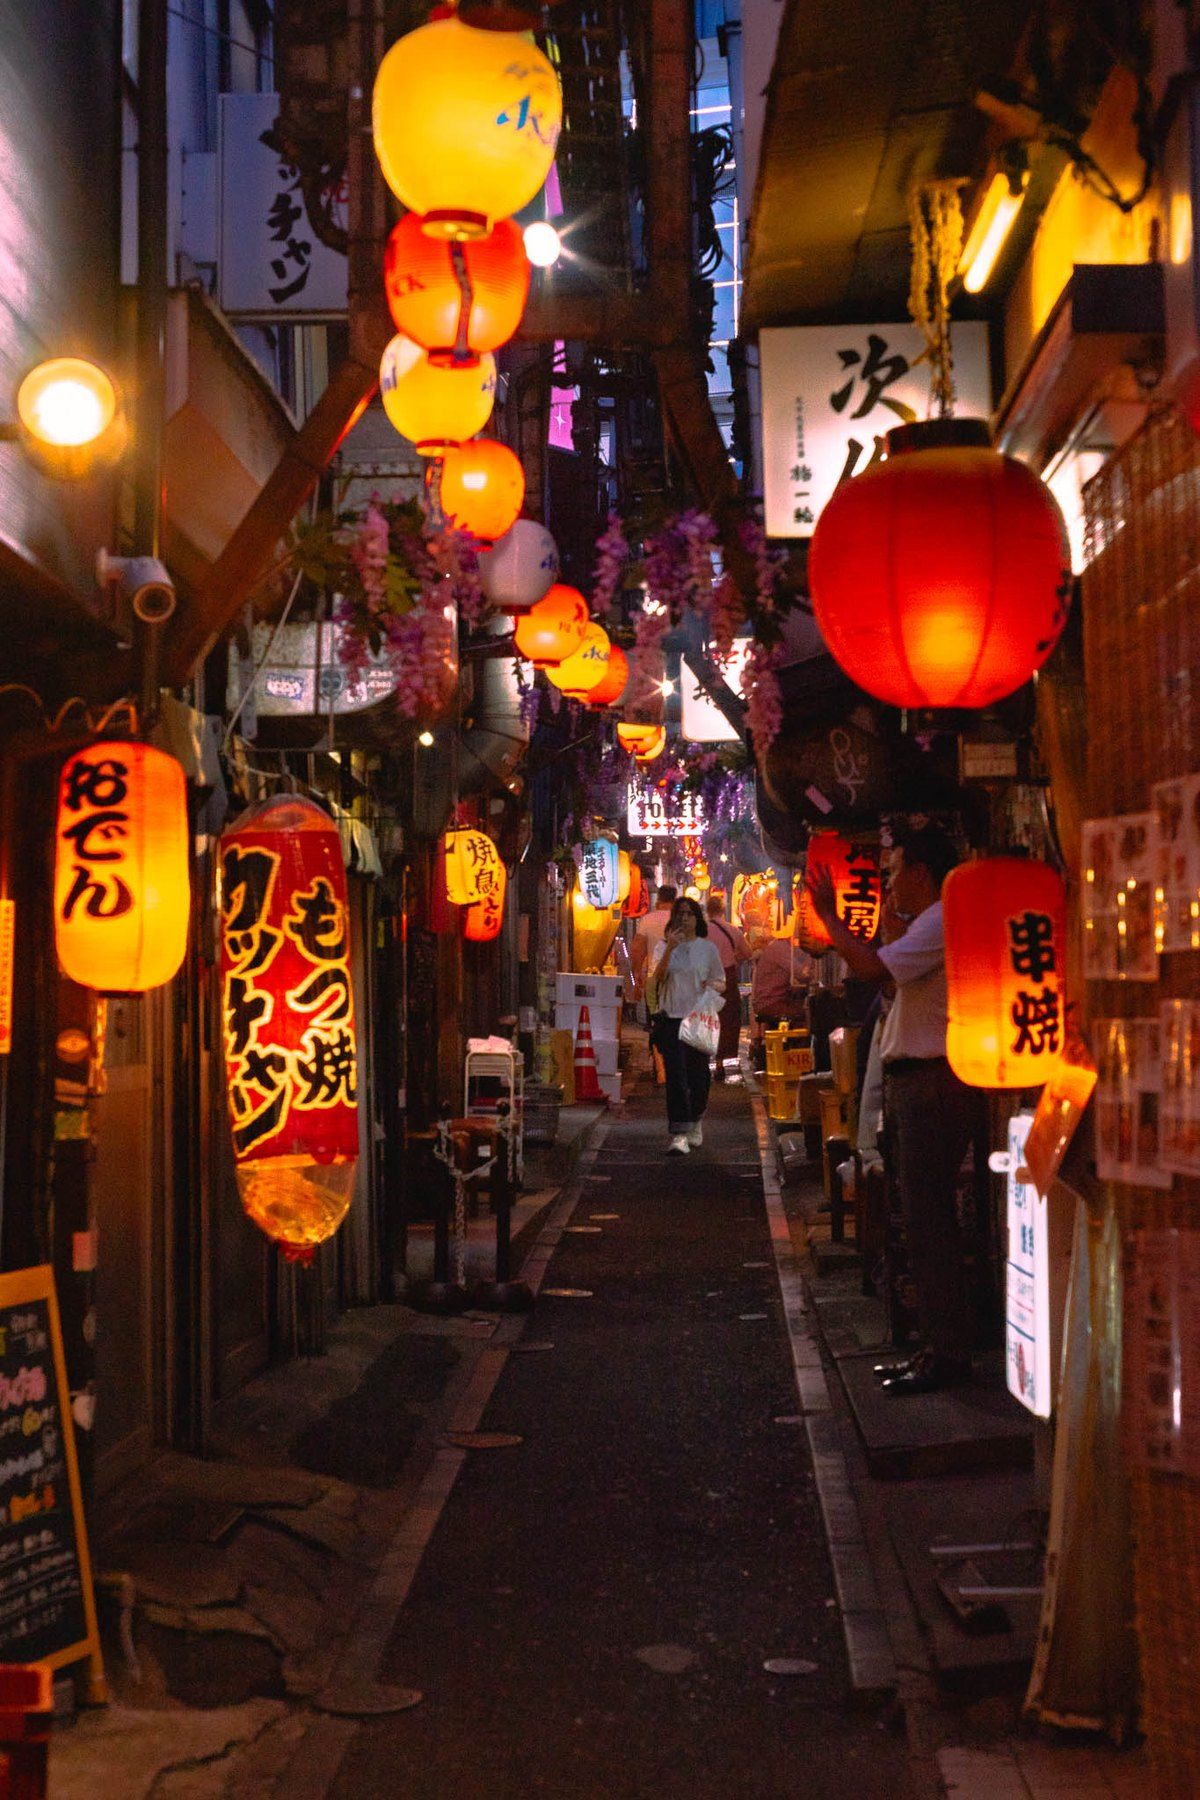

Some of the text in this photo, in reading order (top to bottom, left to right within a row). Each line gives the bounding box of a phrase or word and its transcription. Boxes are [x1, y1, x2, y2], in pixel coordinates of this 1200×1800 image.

[63, 760, 134, 920] おでん
[287, 878, 357, 1107] もつ焼
[1010, 911, 1059, 1055] 串焼
